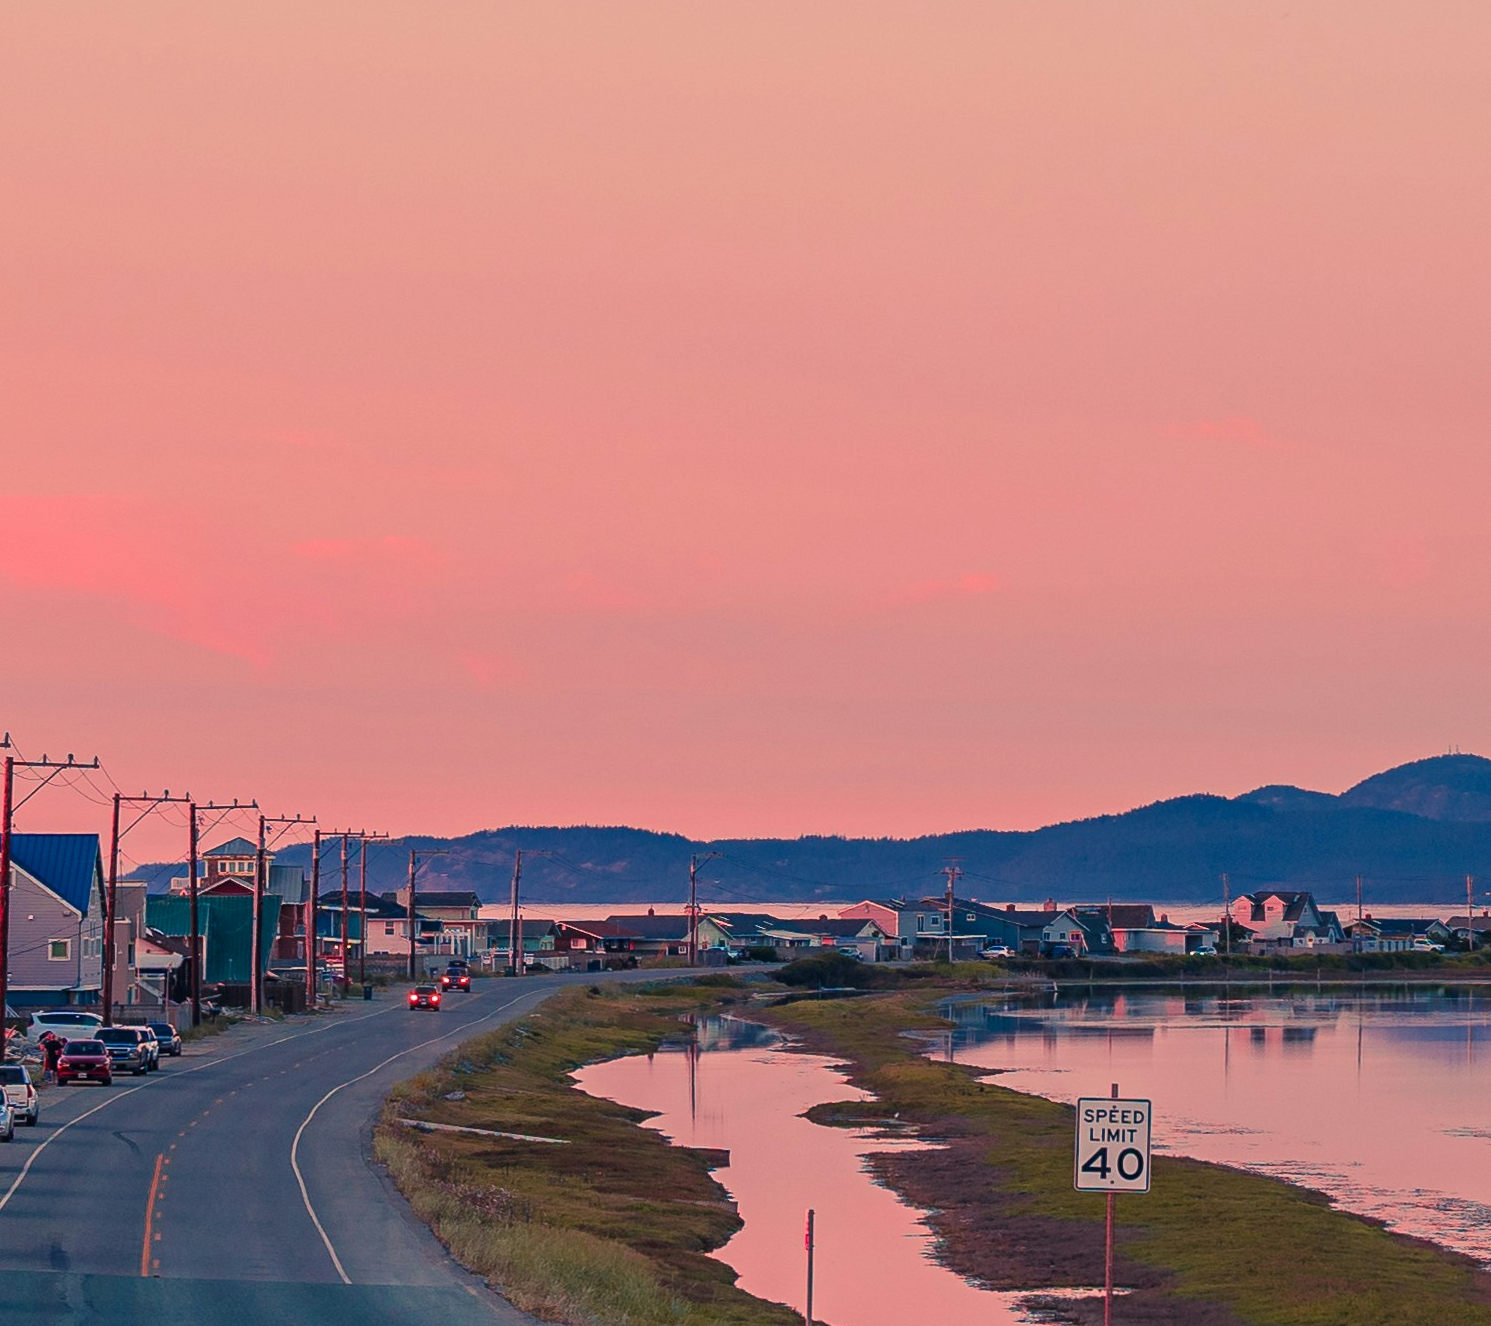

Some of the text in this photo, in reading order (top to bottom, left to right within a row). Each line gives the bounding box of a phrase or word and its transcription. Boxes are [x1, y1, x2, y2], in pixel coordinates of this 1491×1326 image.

[1083, 1108, 1145, 1124] SPEED
[1089, 1128, 1138, 1143] LIMIT
[1081, 1147, 1144, 1181] 40
